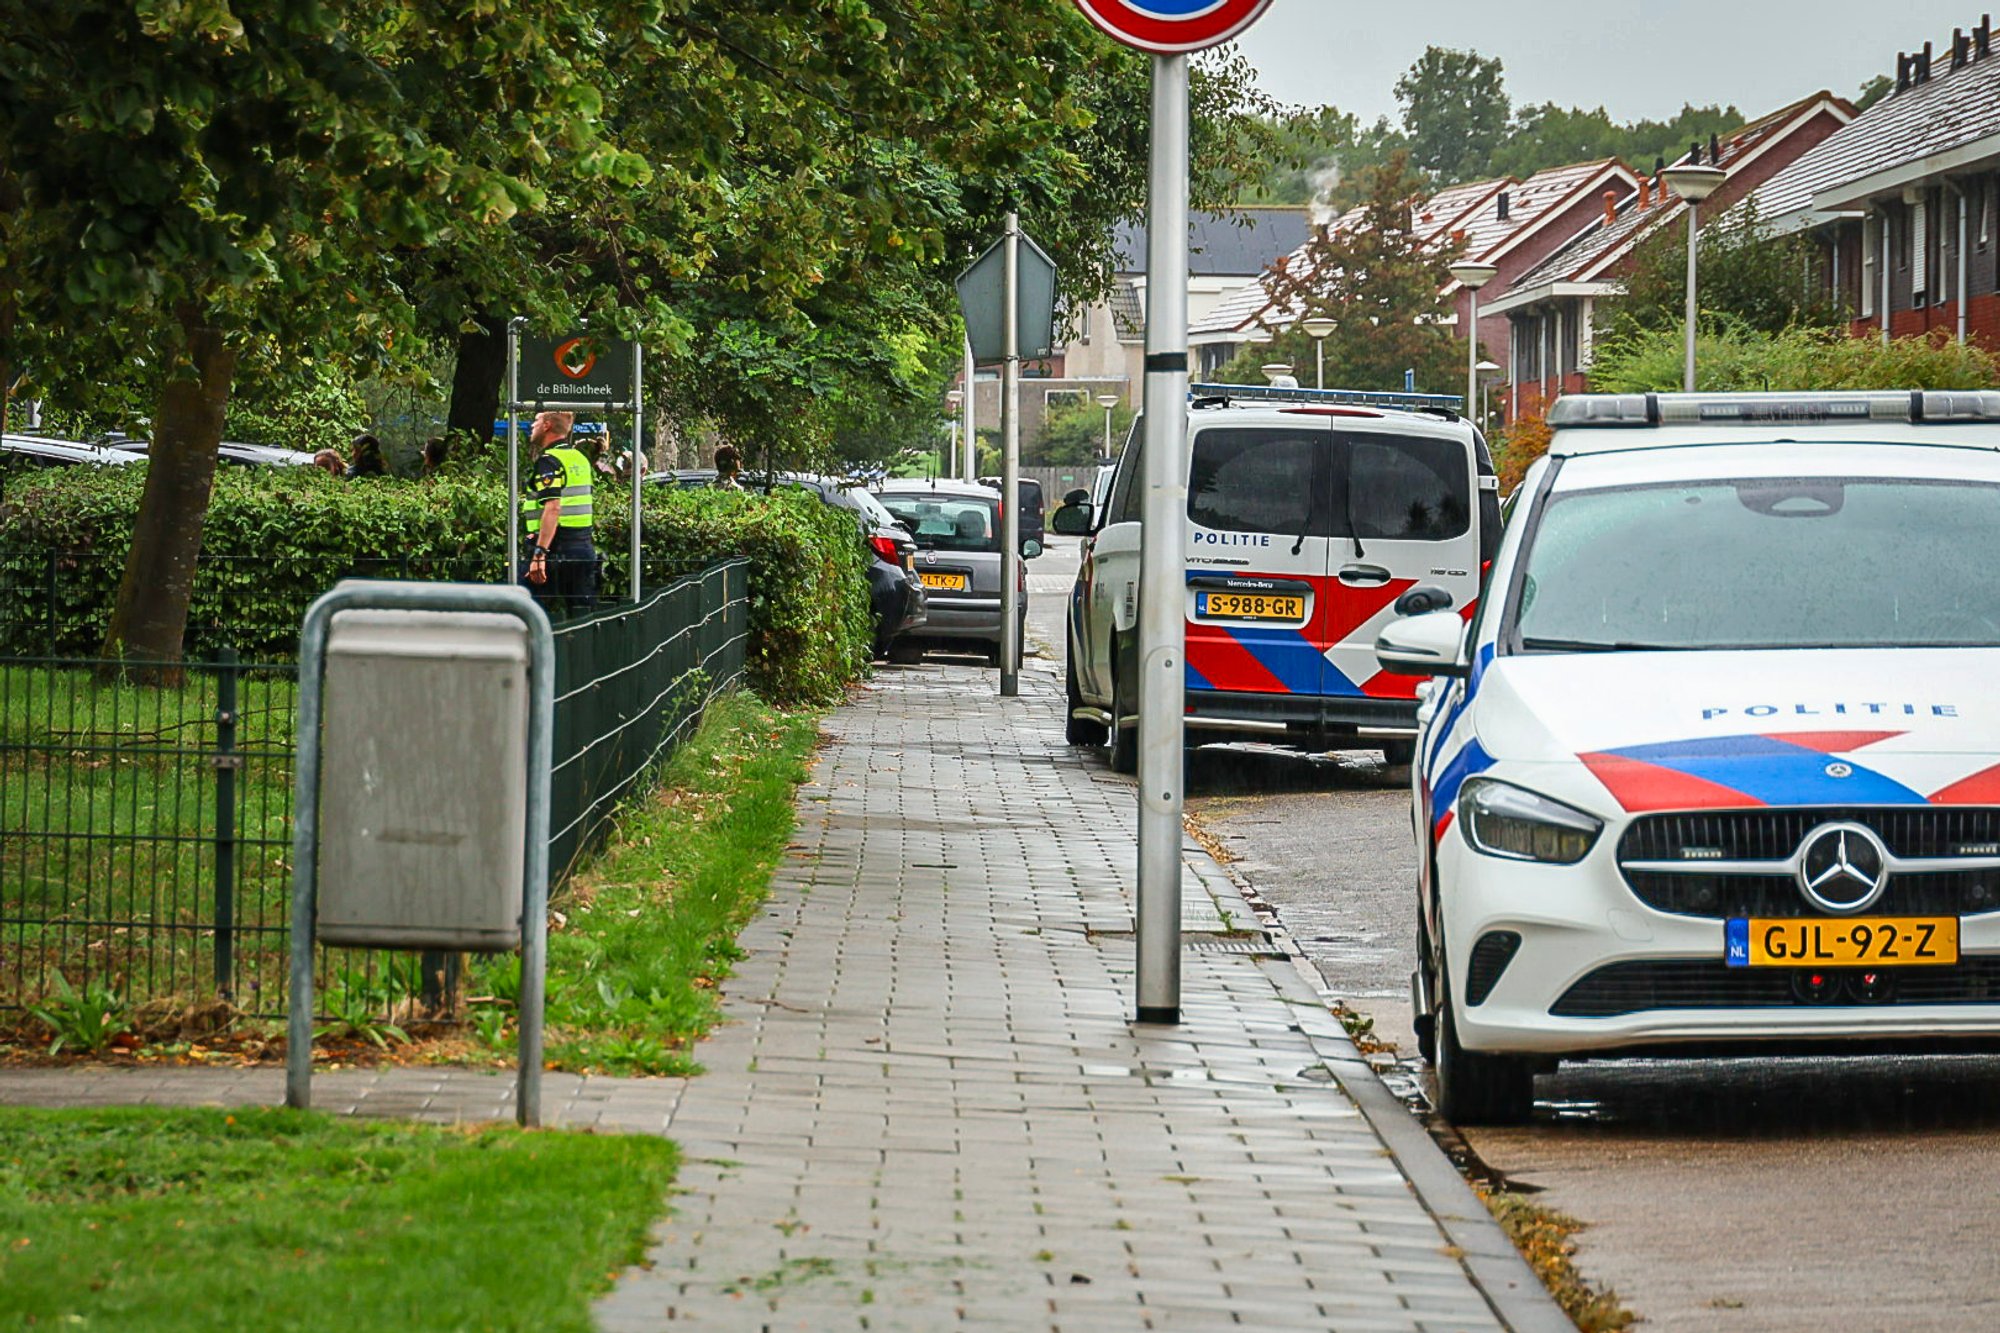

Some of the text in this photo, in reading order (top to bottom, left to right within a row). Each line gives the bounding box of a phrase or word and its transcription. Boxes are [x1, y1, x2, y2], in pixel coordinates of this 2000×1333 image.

[537, 383, 613, 395] de Bibliotheek
[1193, 532, 1270, 547] POLITIE
[1211, 596, 1297, 616] S-988-GR
[1702, 702, 1958, 719] POLITIE
[1730, 923, 1937, 959] NL GJL-92-Z
